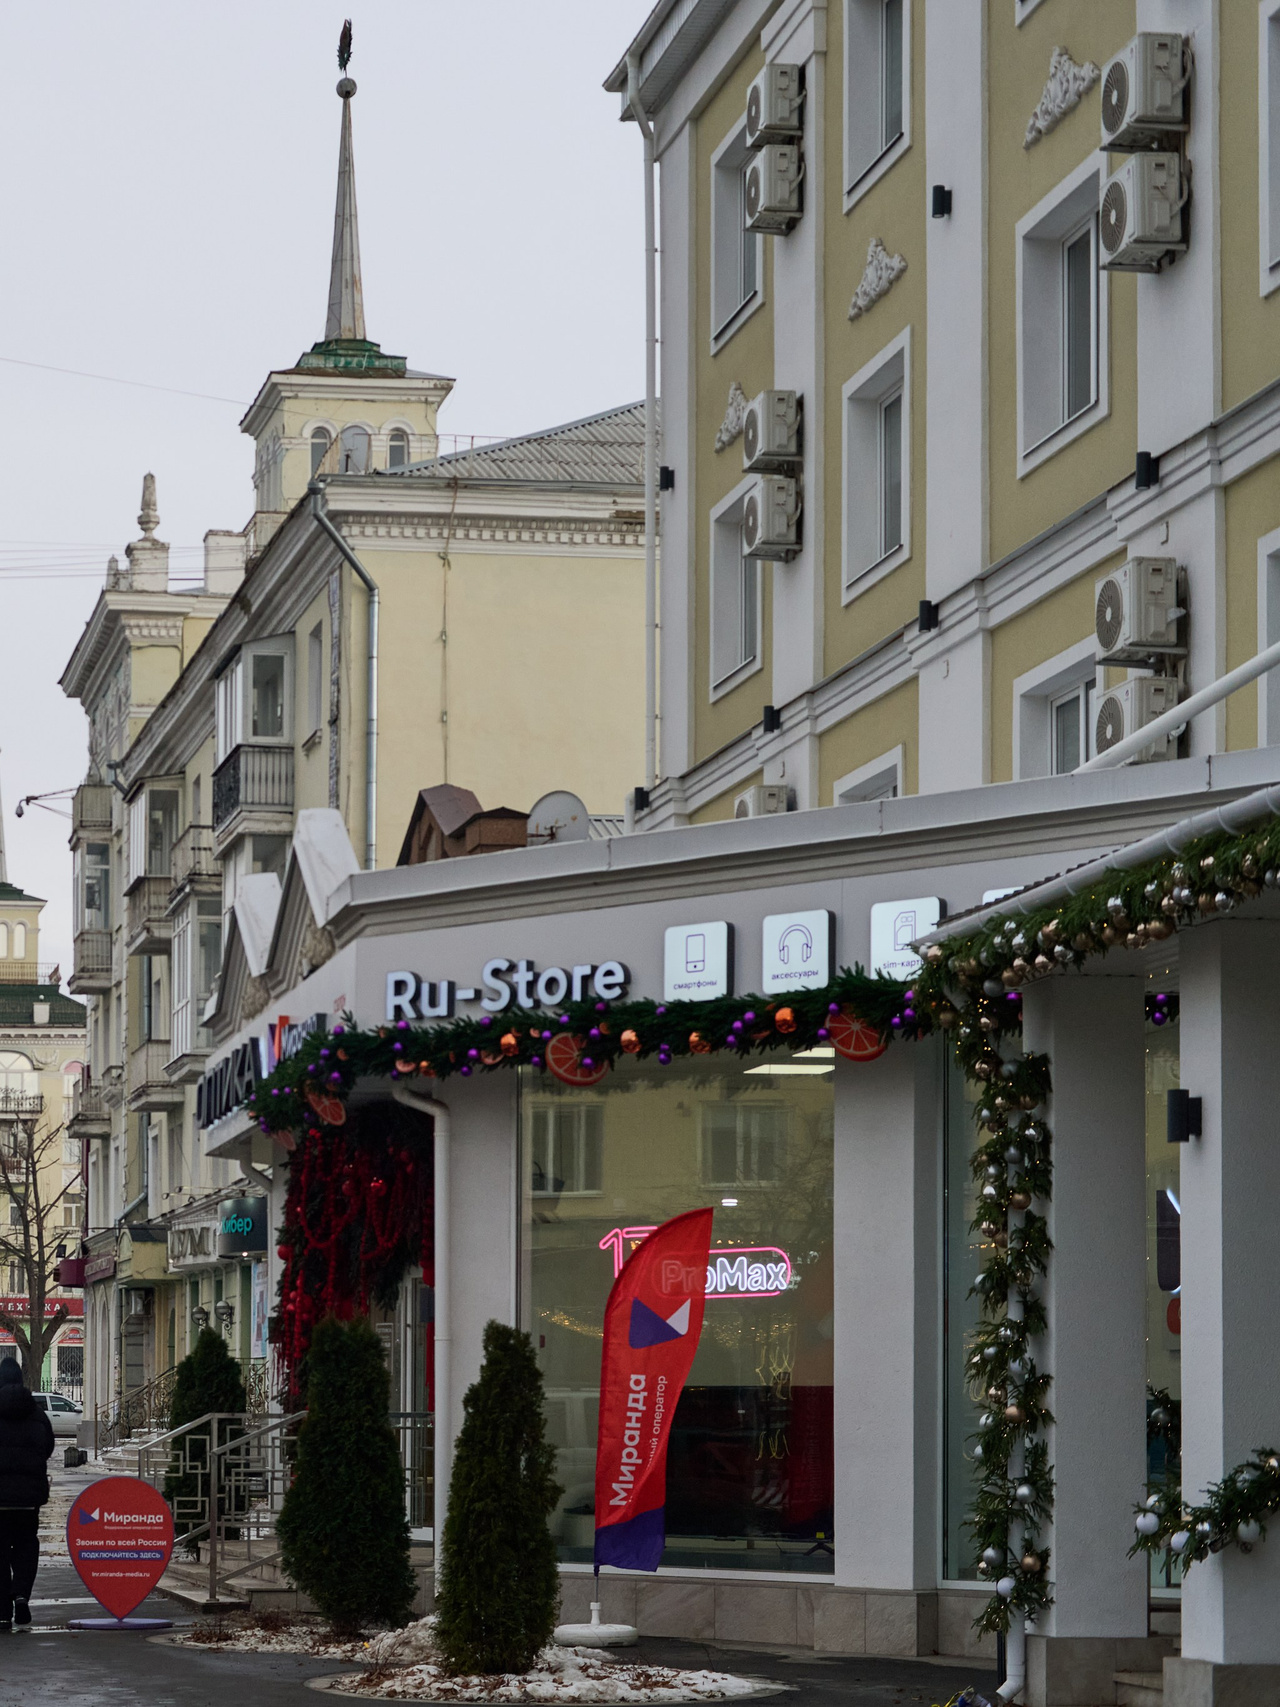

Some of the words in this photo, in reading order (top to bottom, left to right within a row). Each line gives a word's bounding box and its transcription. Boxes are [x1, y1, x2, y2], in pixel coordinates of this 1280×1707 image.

[772, 969, 819, 980] аксессуары
[386, 957, 631, 1021] Ru-Store
[673, 980, 718, 990] смартфоны
[0, 1302, 61, 1312] ТЕХНКА
[652, 1375, 668, 1435] оператор
[609, 1373, 648, 1506] Миранда
[103, 1511, 164, 1525] Миранда
[76, 1538, 104, 1547] Звонки
[117, 1538, 136, 1547] всей
[137, 1538, 167, 1547] России
[81, 1550, 138, 1559] ПОДКЛЮЧАЙТЕСЬ
[139, 1551, 161, 1559] ЗДЕСЬ
